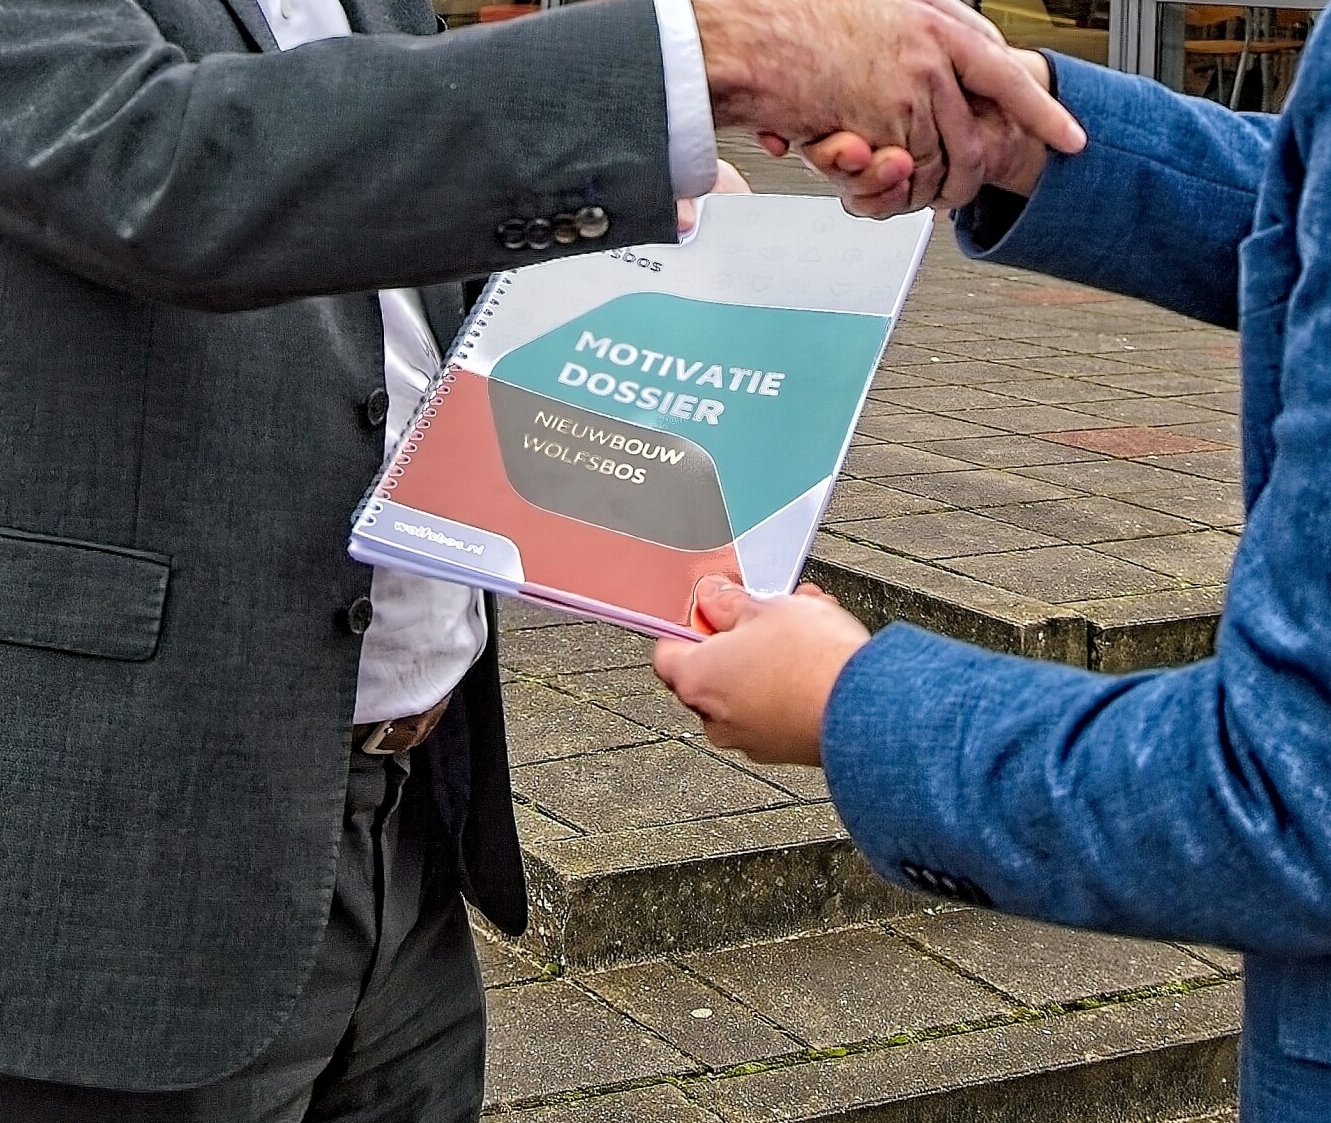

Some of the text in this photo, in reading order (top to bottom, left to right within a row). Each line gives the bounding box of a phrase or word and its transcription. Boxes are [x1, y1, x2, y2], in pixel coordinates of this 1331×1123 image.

[557, 361, 725, 425] DOSSIER
[574, 330, 786, 397] MOTIVATIE
[522, 433, 648, 485] WOLFSBOS
[533, 411, 686, 466] NIEUWBOUW
